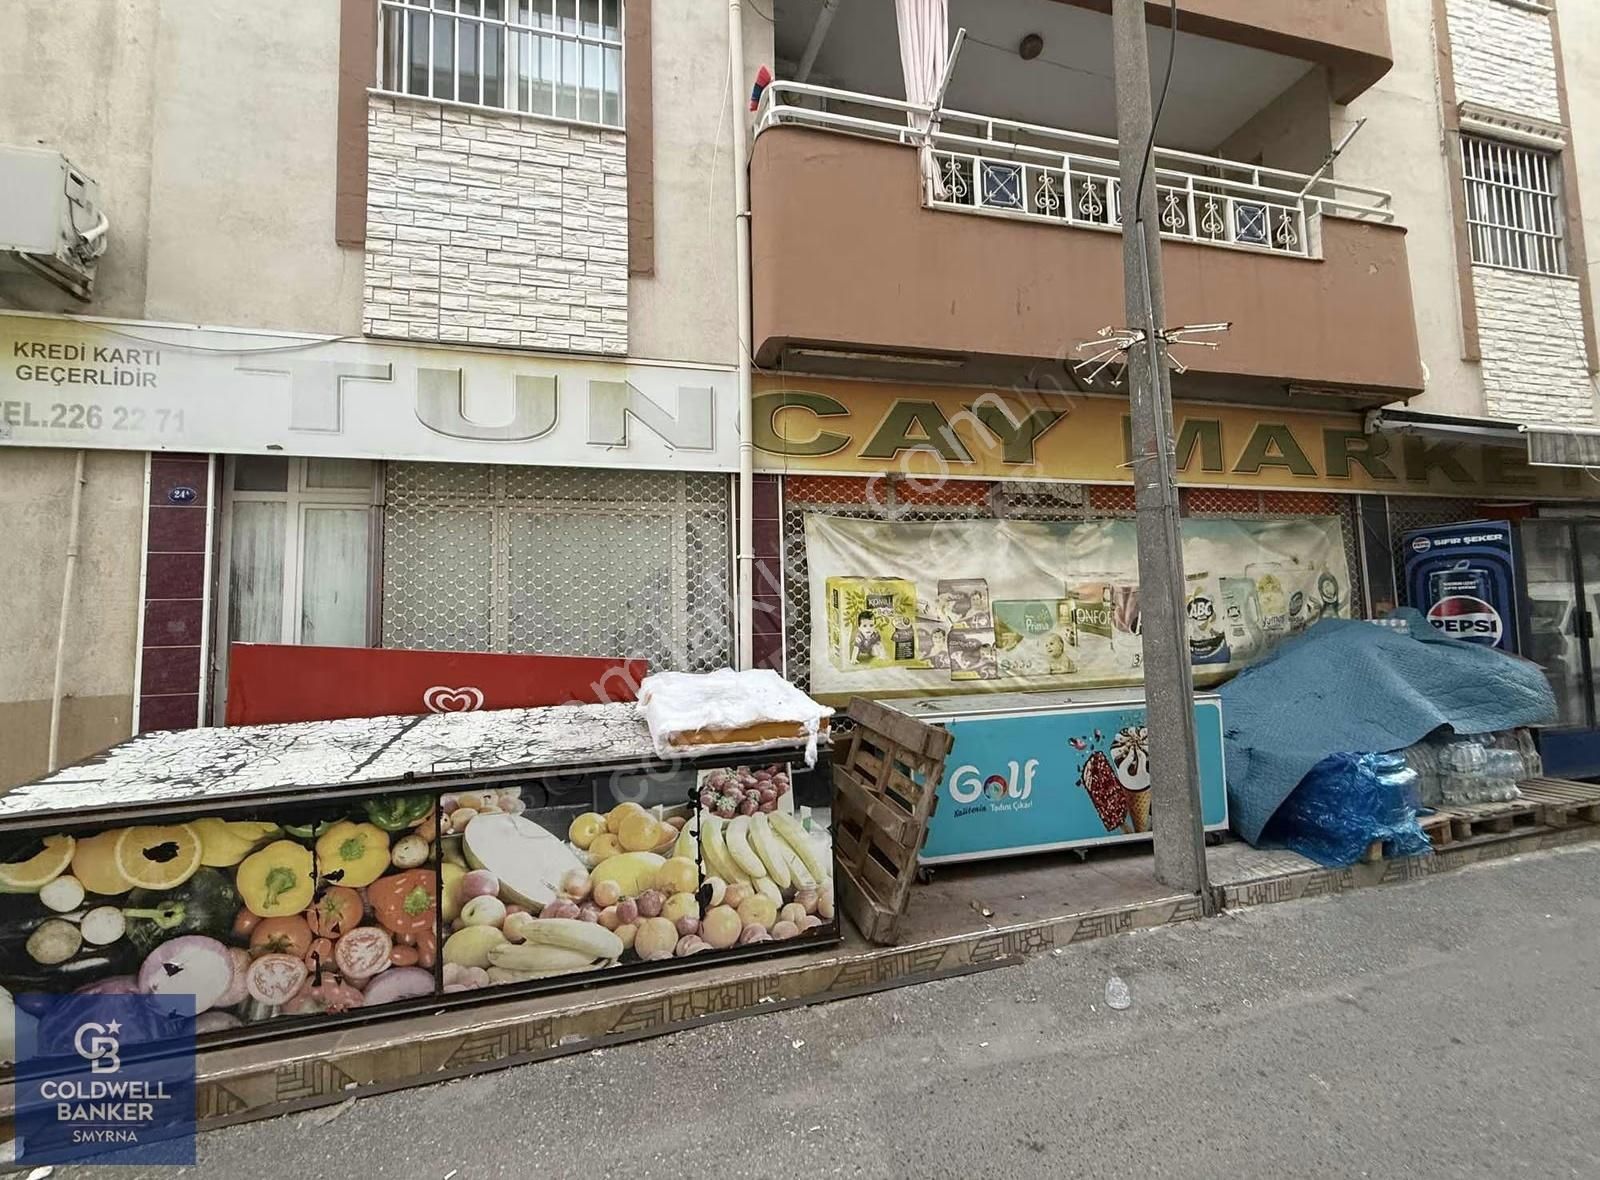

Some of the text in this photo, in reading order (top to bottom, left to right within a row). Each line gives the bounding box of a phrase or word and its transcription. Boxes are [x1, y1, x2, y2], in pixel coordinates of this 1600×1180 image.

[14, 341, 161, 366] KREDİ KARTI
[15, 365, 157, 388] GEÇERLİDİR
[0, 400, 185, 433] EL.226 22 71
[234, 358, 1070, 464] TUNCAY
[1120, 411, 1582, 487] MARKE
[1463, 533, 1503, 545] ŞEKER
[1430, 619, 1498, 633] PEPSI
[949, 758, 1039, 804] Golf
